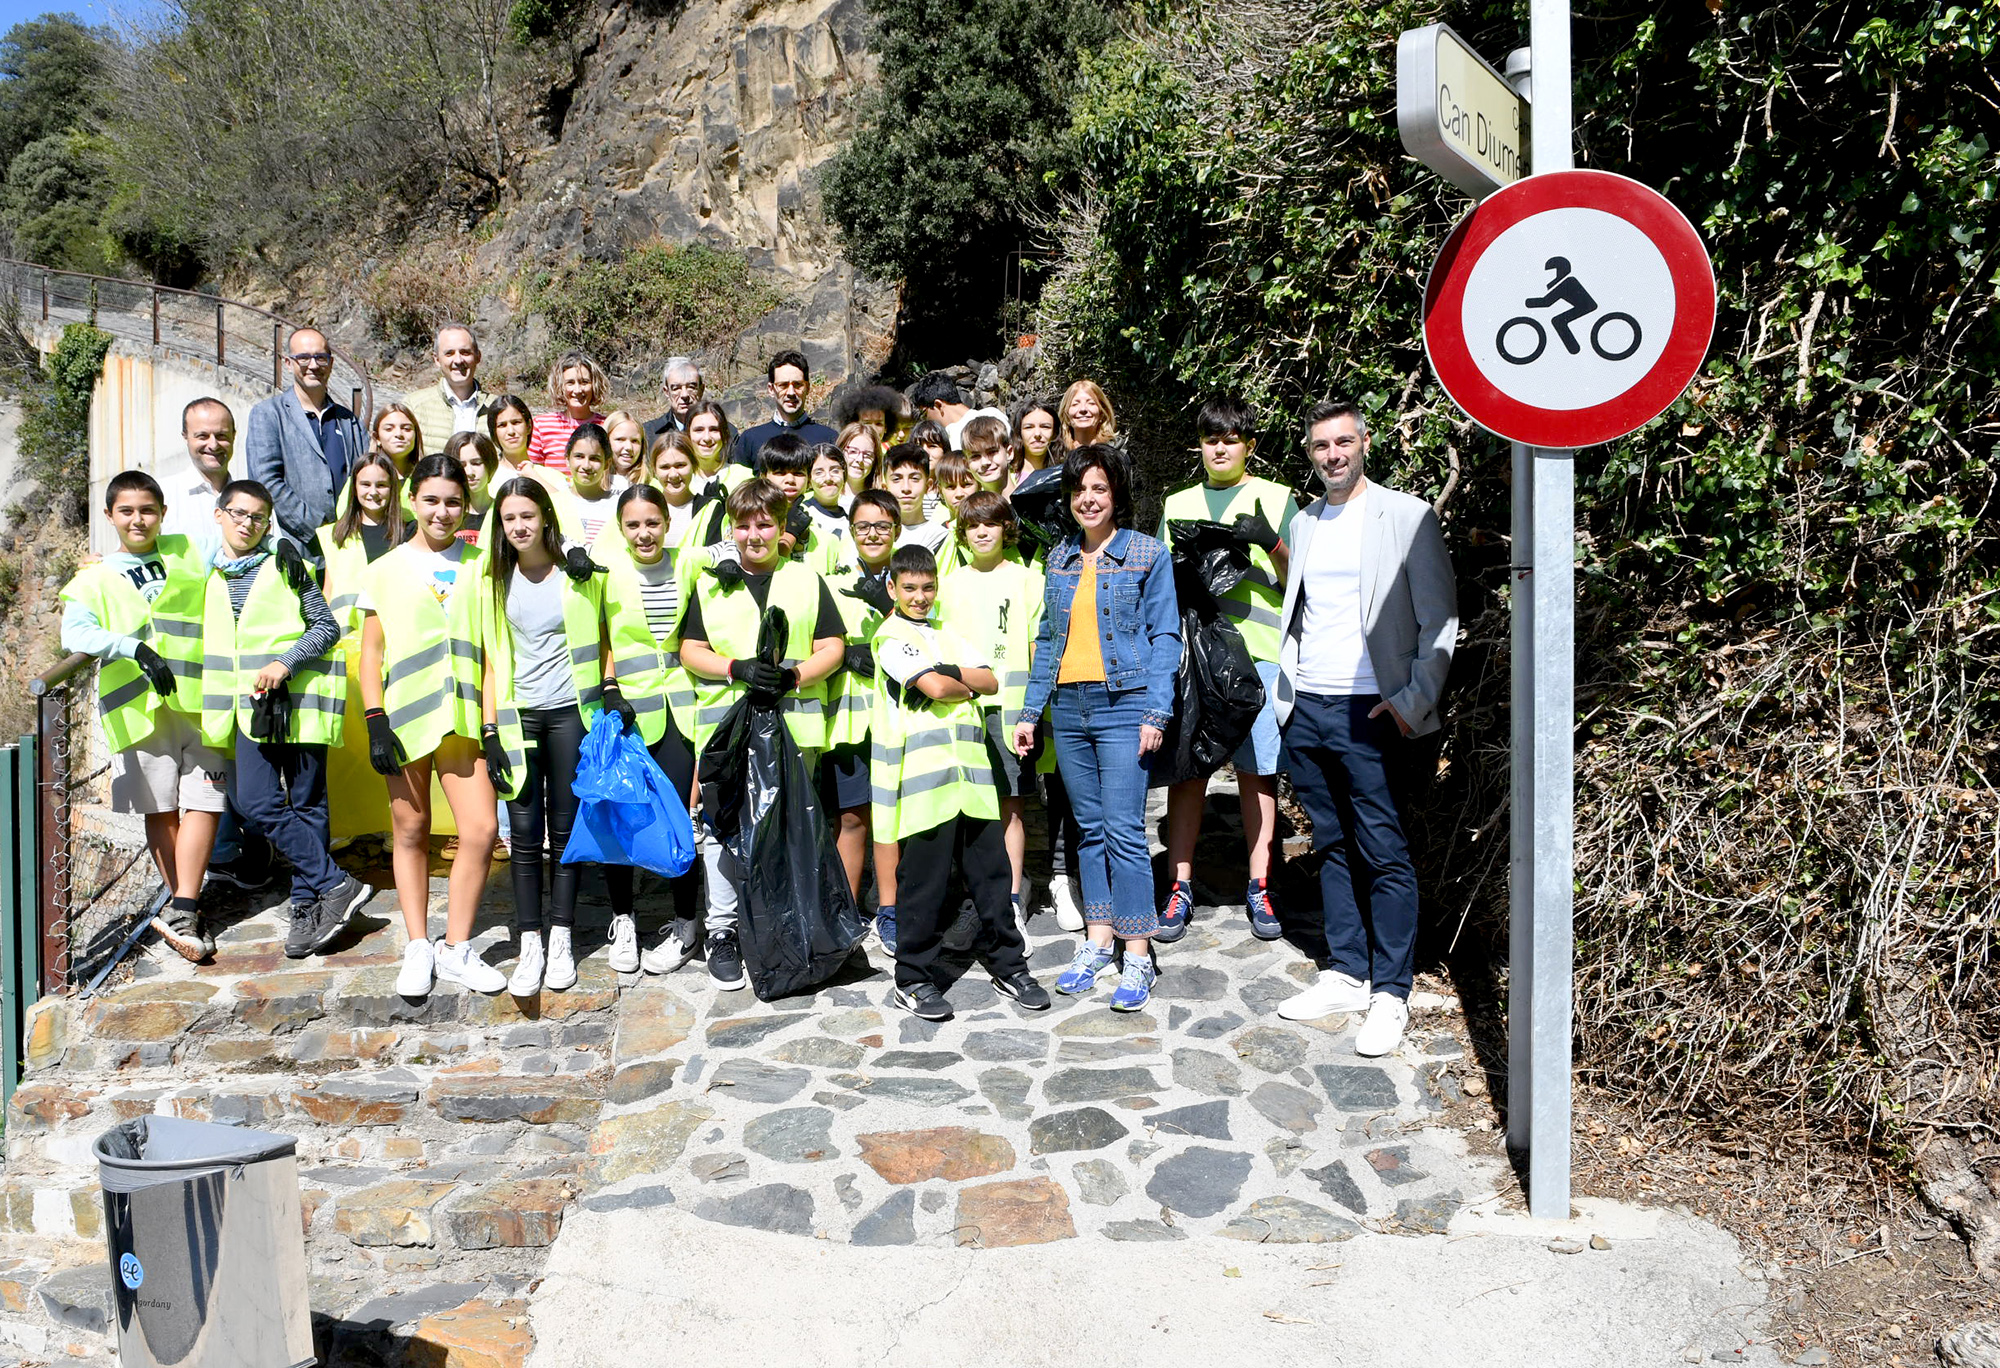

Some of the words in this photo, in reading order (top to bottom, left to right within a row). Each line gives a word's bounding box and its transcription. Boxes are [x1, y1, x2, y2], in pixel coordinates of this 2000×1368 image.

[1439, 83, 1470, 146] Can
[120, 560, 167, 591] ND
[204, 770, 229, 781] NA
